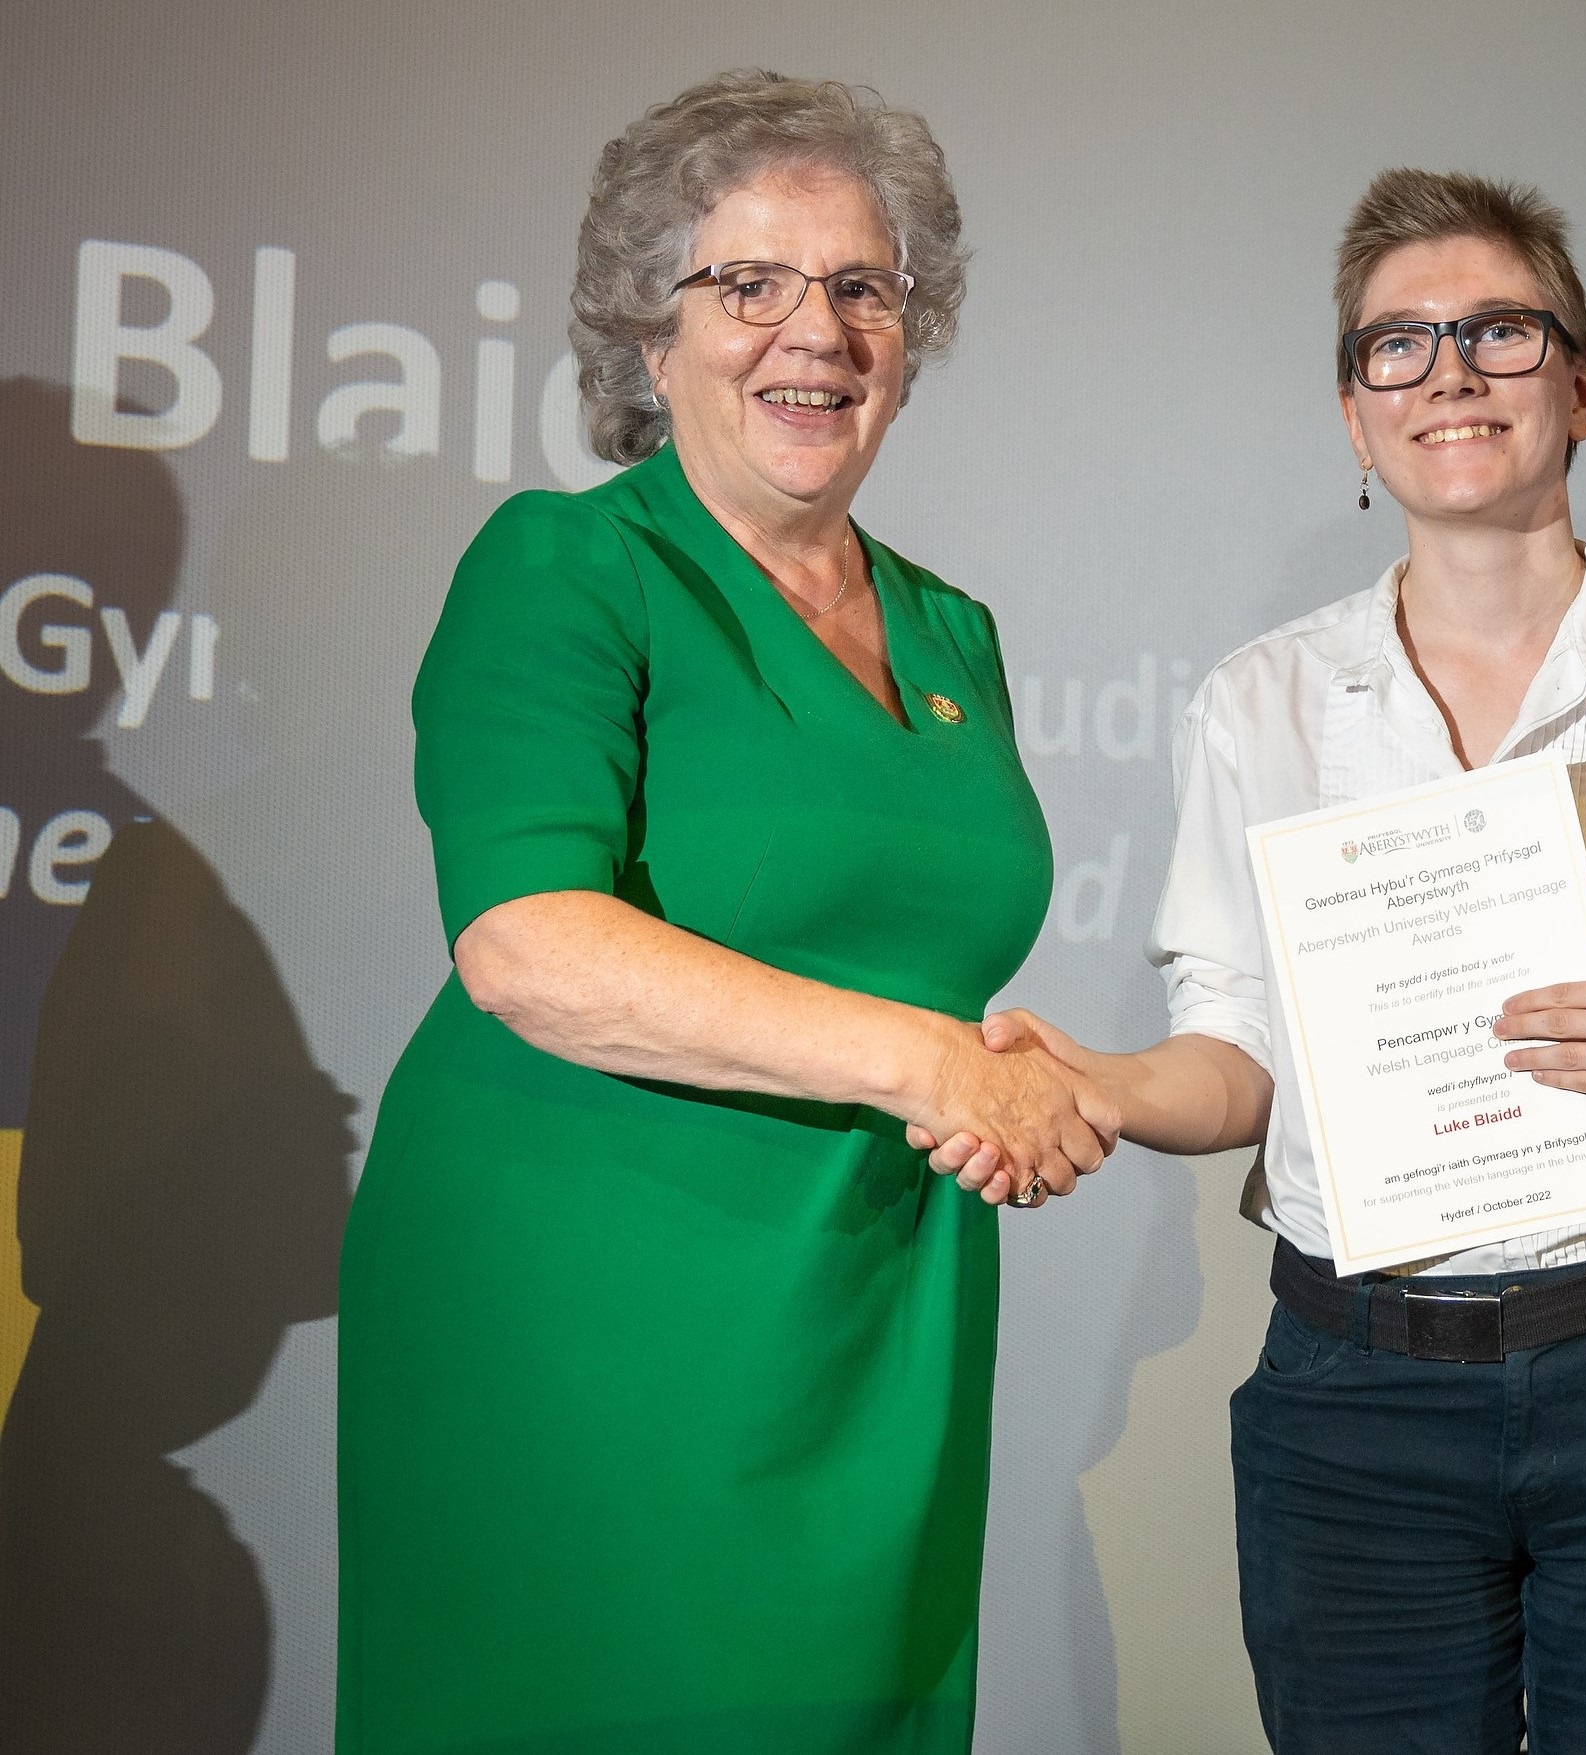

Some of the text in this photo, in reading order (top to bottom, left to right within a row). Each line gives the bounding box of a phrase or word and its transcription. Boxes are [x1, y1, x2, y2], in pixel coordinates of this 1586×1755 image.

[1360, 823, 1450, 856] ABERYSTWYTH
[1305, 841, 1542, 910] Gwobrau Hybu'r Gymraeg Prifysgol
[1387, 880, 1469, 910] Aberystwyth
[1298, 878, 1567, 955] Aberystwyth University Welsh Language
[1412, 924, 1463, 946] Awards
[1376, 952, 1515, 993] Hyn sydd i dystio bod y wobr
[1368, 967, 1531, 1014] This is to certify that the award for
[1377, 1023, 1459, 1051] Pencampwr
[1462, 1021, 1471, 1034] y
[1367, 1057, 1411, 1077] Welsh
[1415, 1040, 1484, 1066] Language
[1458, 1071, 1507, 1089] chyflwyno
[1437, 1089, 1510, 1112] is presented to
[1434, 1106, 1522, 1135] Luke Blaidd
[1384, 1173, 1401, 1185] am
[1403, 1163, 1446, 1183] gefnogi'r
[1449, 1159, 1470, 1172] iaith
[1472, 1149, 1519, 1168] Gymraeg
[1521, 1145, 1533, 1157] yn
[1535, 1143, 1542, 1154] y
[1363, 1196, 1377, 1208] for
[1379, 1185, 1433, 1205] supporting
[1435, 1181, 1451, 1192] the
[1453, 1173, 1485, 1188] Welsh
[1487, 1163, 1534, 1182] language
[1536, 1160, 1546, 1170] in
[1548, 1156, 1564, 1168] the
[1441, 1207, 1475, 1222] Hydref
[1483, 1196, 1523, 1213] October
[1526, 1190, 1552, 1205] 2022
